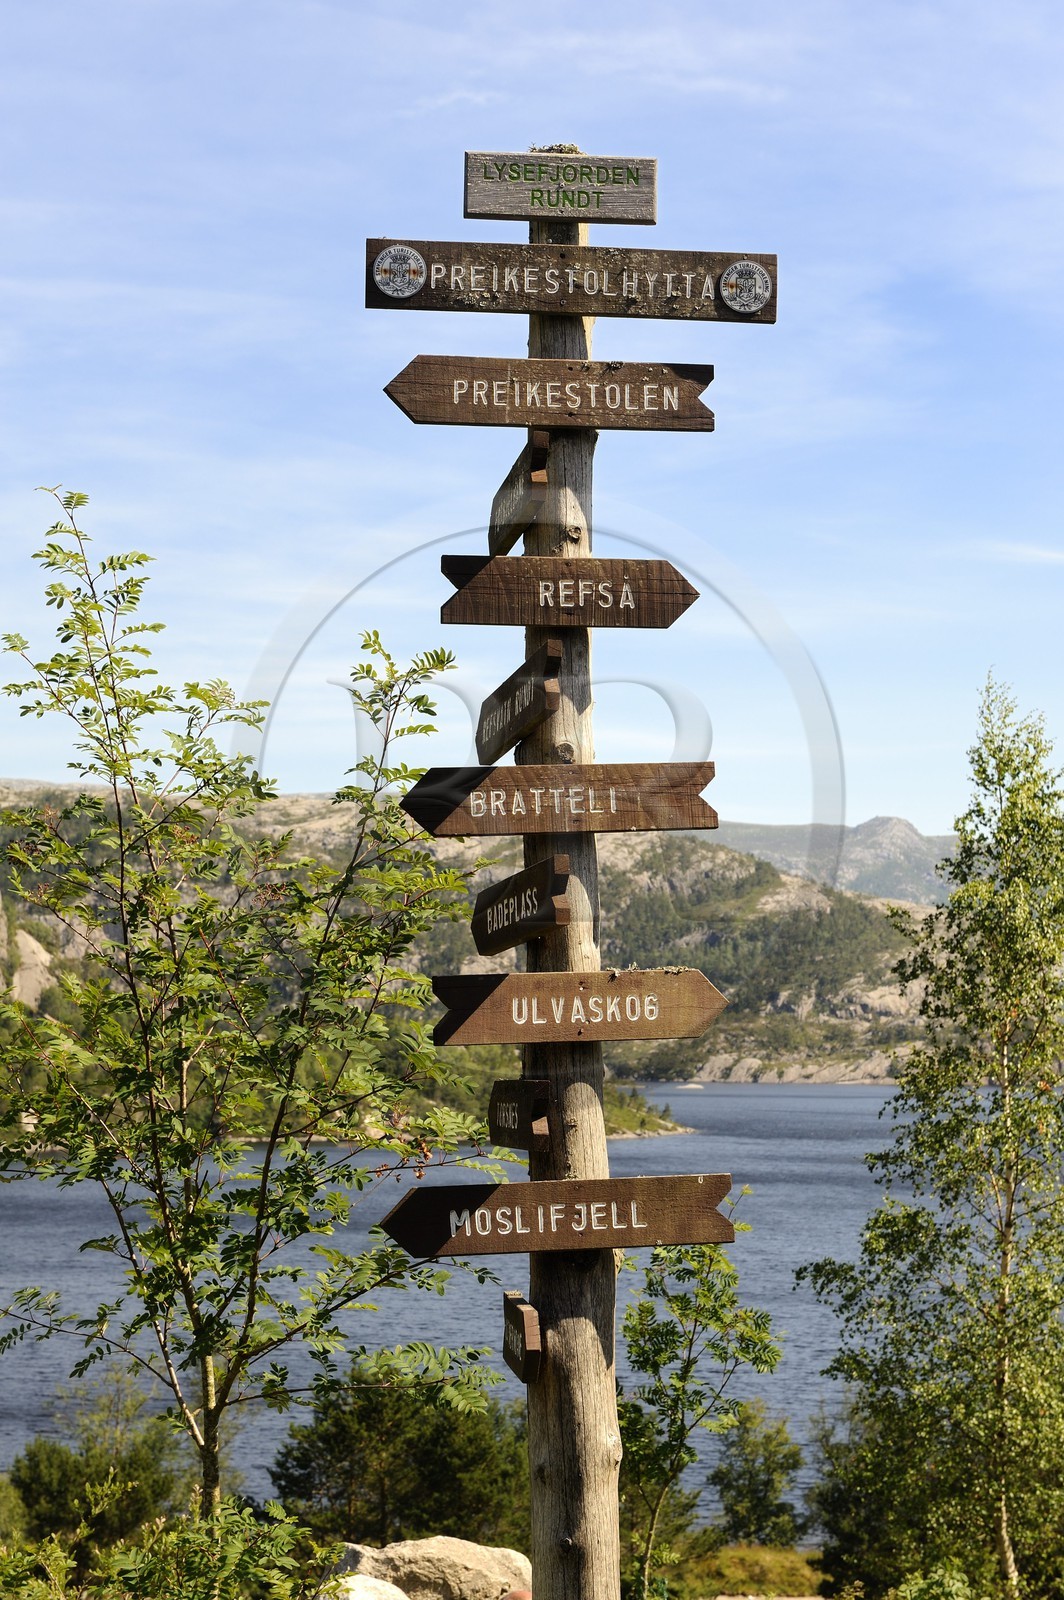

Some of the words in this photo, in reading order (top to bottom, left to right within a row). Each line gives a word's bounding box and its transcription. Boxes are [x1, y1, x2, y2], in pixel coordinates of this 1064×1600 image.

[483, 162, 640, 186] LYSEFJORDEN
[530, 188, 604, 209] RUNDT
[429, 263, 715, 301] PREIKESTOLHYTTA
[453, 379, 679, 411] PREIKESTOLEN
[539, 574, 636, 609] REFSÅ
[470, 785, 617, 818] BRATTELI
[487, 886, 538, 934] BADEPLASS
[512, 992, 659, 1025] ULVASKOG
[449, 1199, 648, 1239] MOSLIFJELL
